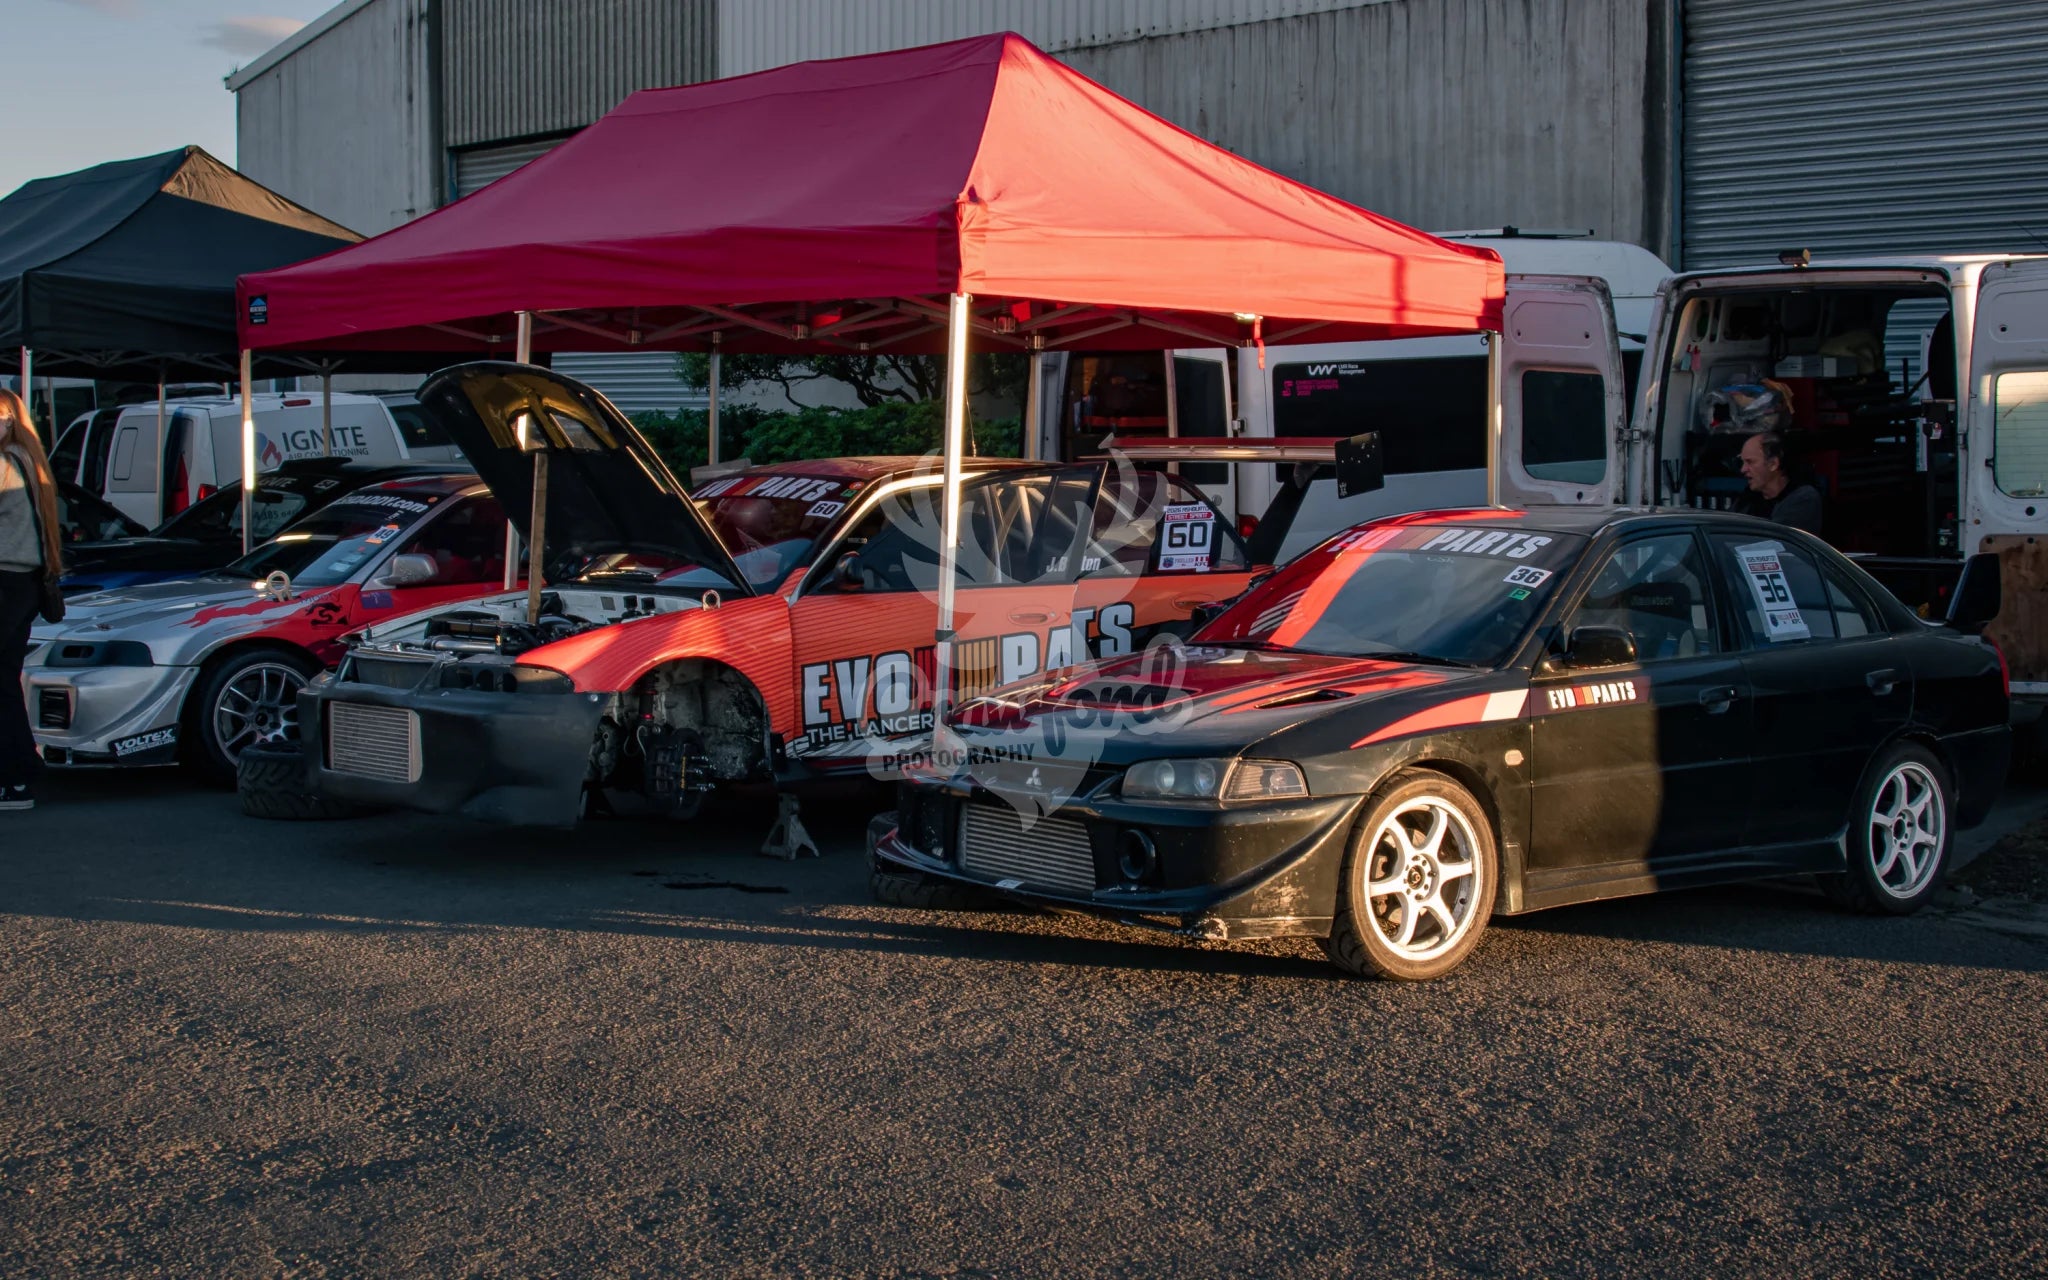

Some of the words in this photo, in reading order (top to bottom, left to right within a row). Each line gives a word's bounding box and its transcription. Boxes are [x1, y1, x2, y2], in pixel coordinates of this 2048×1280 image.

[282, 426, 367, 452] IGNITE
[304, 448, 369, 459] CONTIONING
[745, 476, 841, 501] PARTS
[812, 503, 839, 515] 60
[1168, 522, 1208, 548] 60
[1327, 528, 1405, 552] EVO
[1420, 529, 1552, 558] PARTS
[1511, 568, 1545, 584] 36
[1756, 573, 1790, 603] 36
[803, 653, 911, 726] EVO
[1548, 688, 1576, 709] EVO
[1591, 681, 1637, 704] PARTS
[807, 727, 844, 745] THE
[855, 713, 935, 739] LANCER
